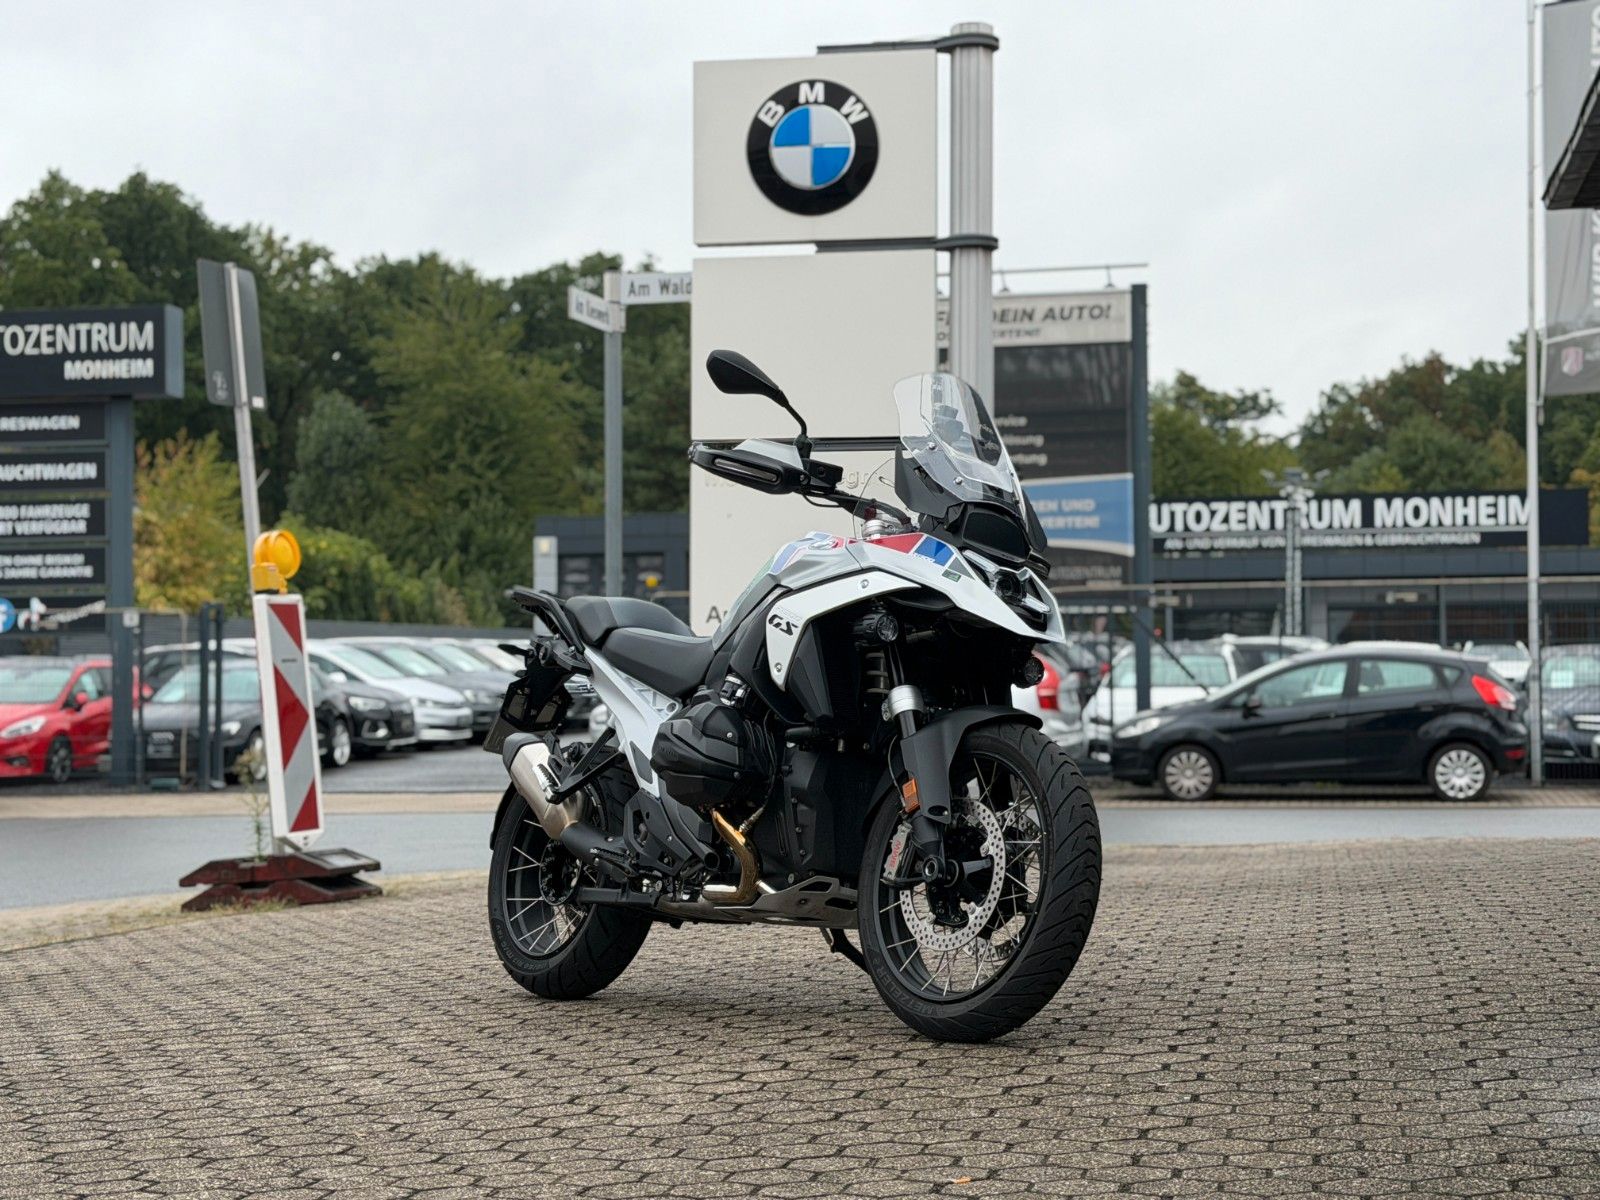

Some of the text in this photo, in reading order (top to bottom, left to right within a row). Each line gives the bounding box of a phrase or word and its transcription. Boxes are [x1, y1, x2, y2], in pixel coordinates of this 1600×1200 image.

[758, 81, 869, 128] BMW
[628, 281, 651, 297] Am
[992, 304, 1111, 324] EIN AUTO!
[0, 321, 154, 356] OZENTRUM
[64, 358, 154, 380] MONHEIM
[1149, 495, 1530, 533] UTOZENTRUM MONHEIM
[768, 614, 799, 636] GS
